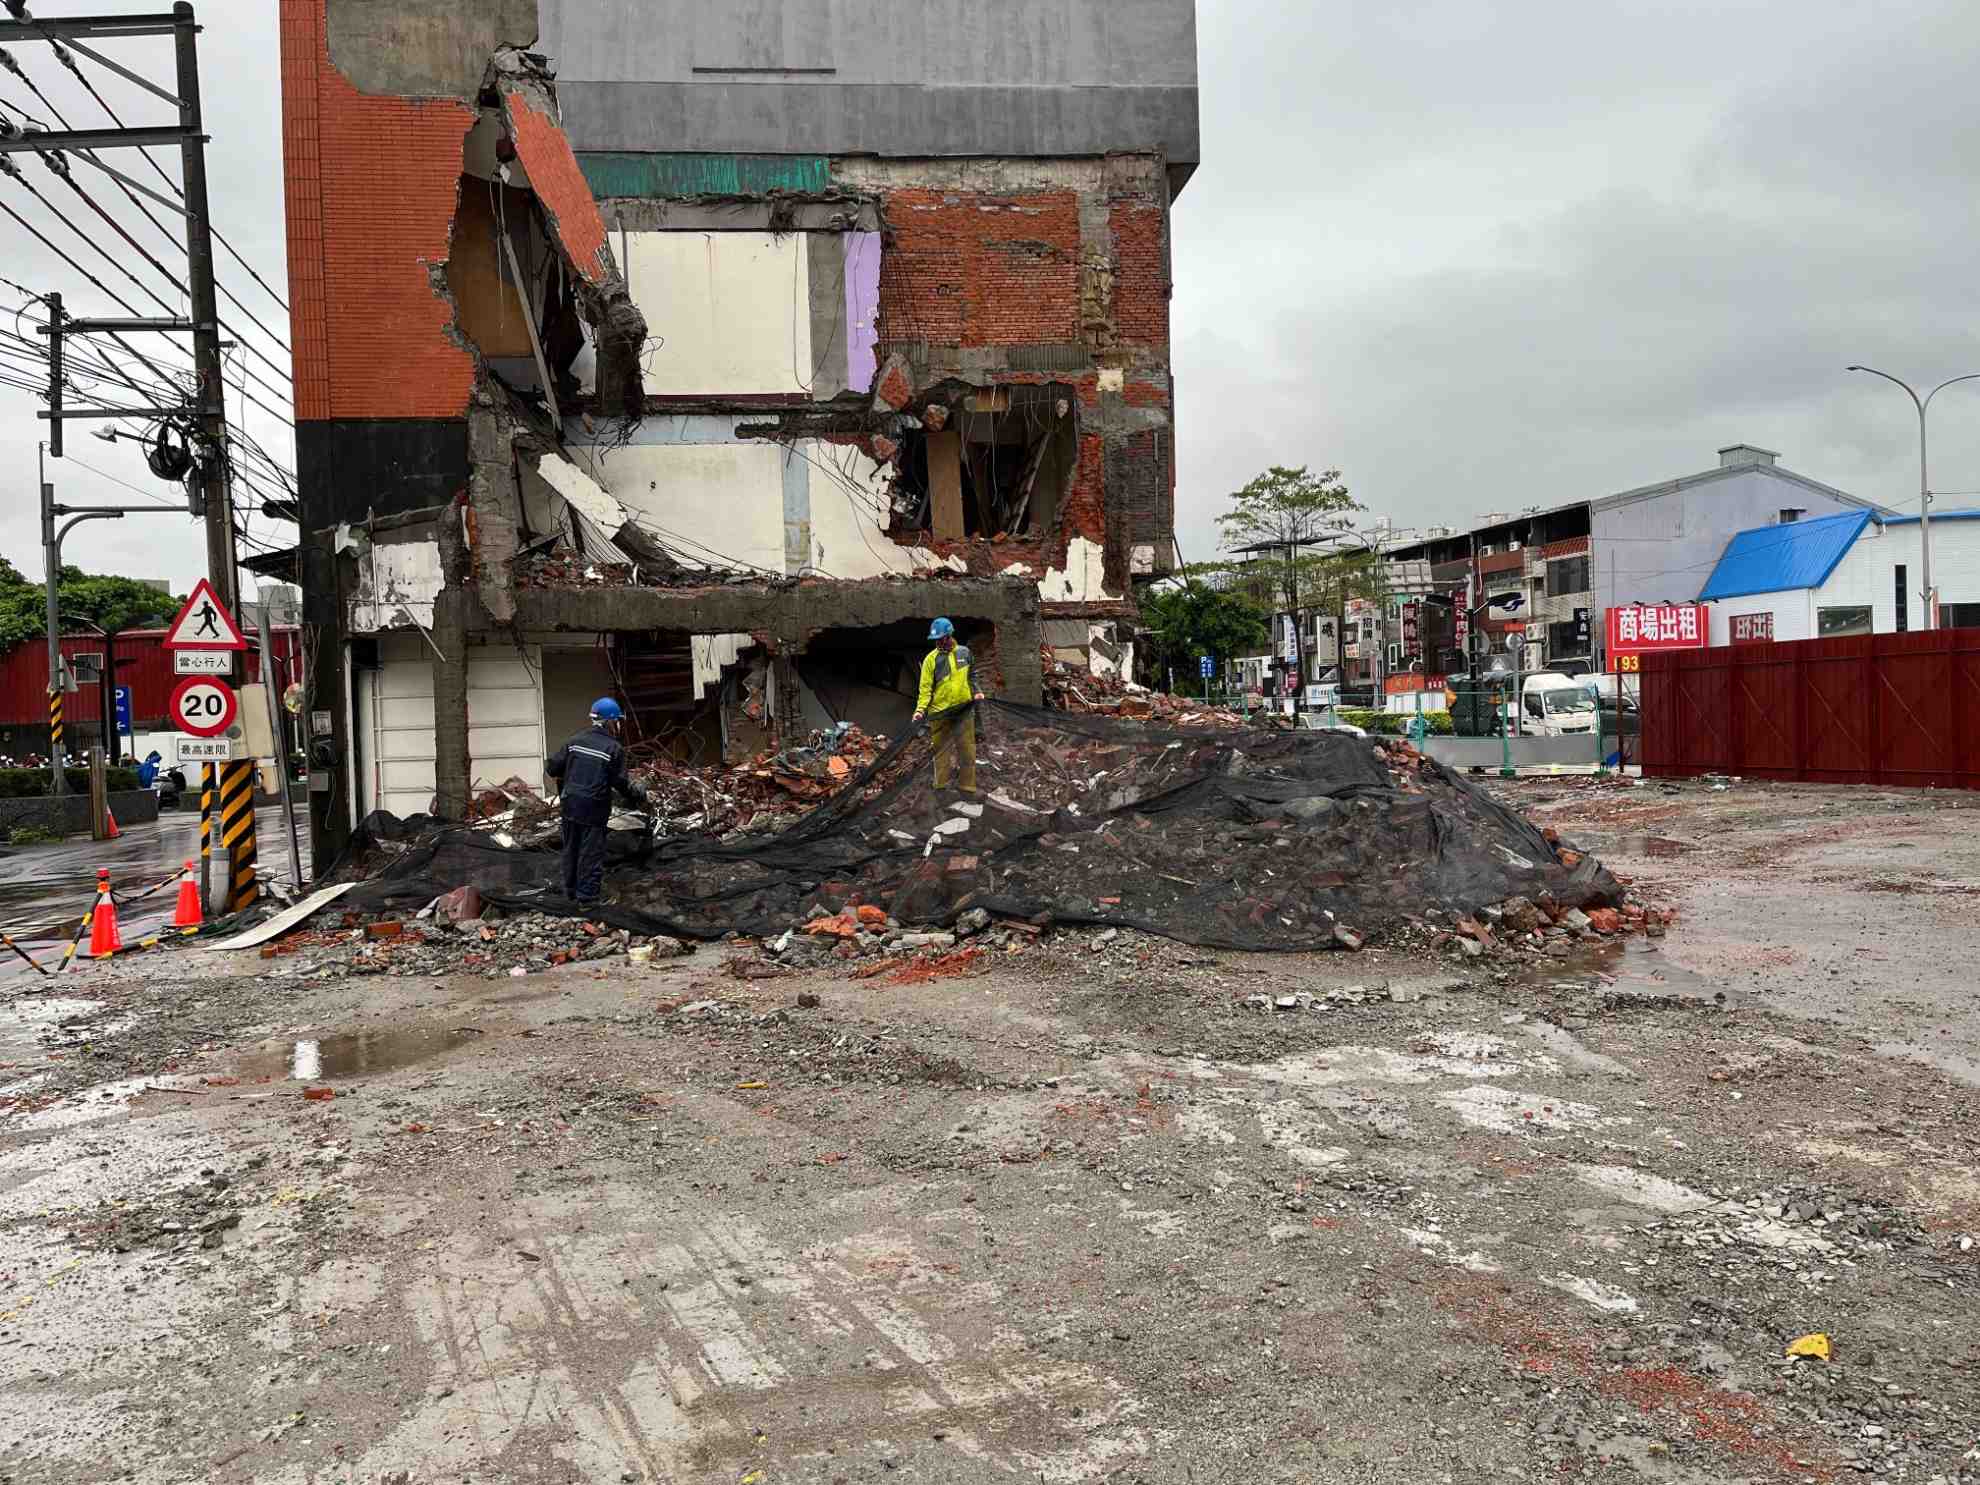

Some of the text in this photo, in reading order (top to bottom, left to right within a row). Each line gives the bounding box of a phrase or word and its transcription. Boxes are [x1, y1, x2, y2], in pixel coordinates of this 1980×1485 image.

[1619, 608, 1697, 641] 商場出租
[178, 656, 227, 668] 當心行人
[184, 694, 222, 717] 20
[181, 744, 227, 756] 最高速限
